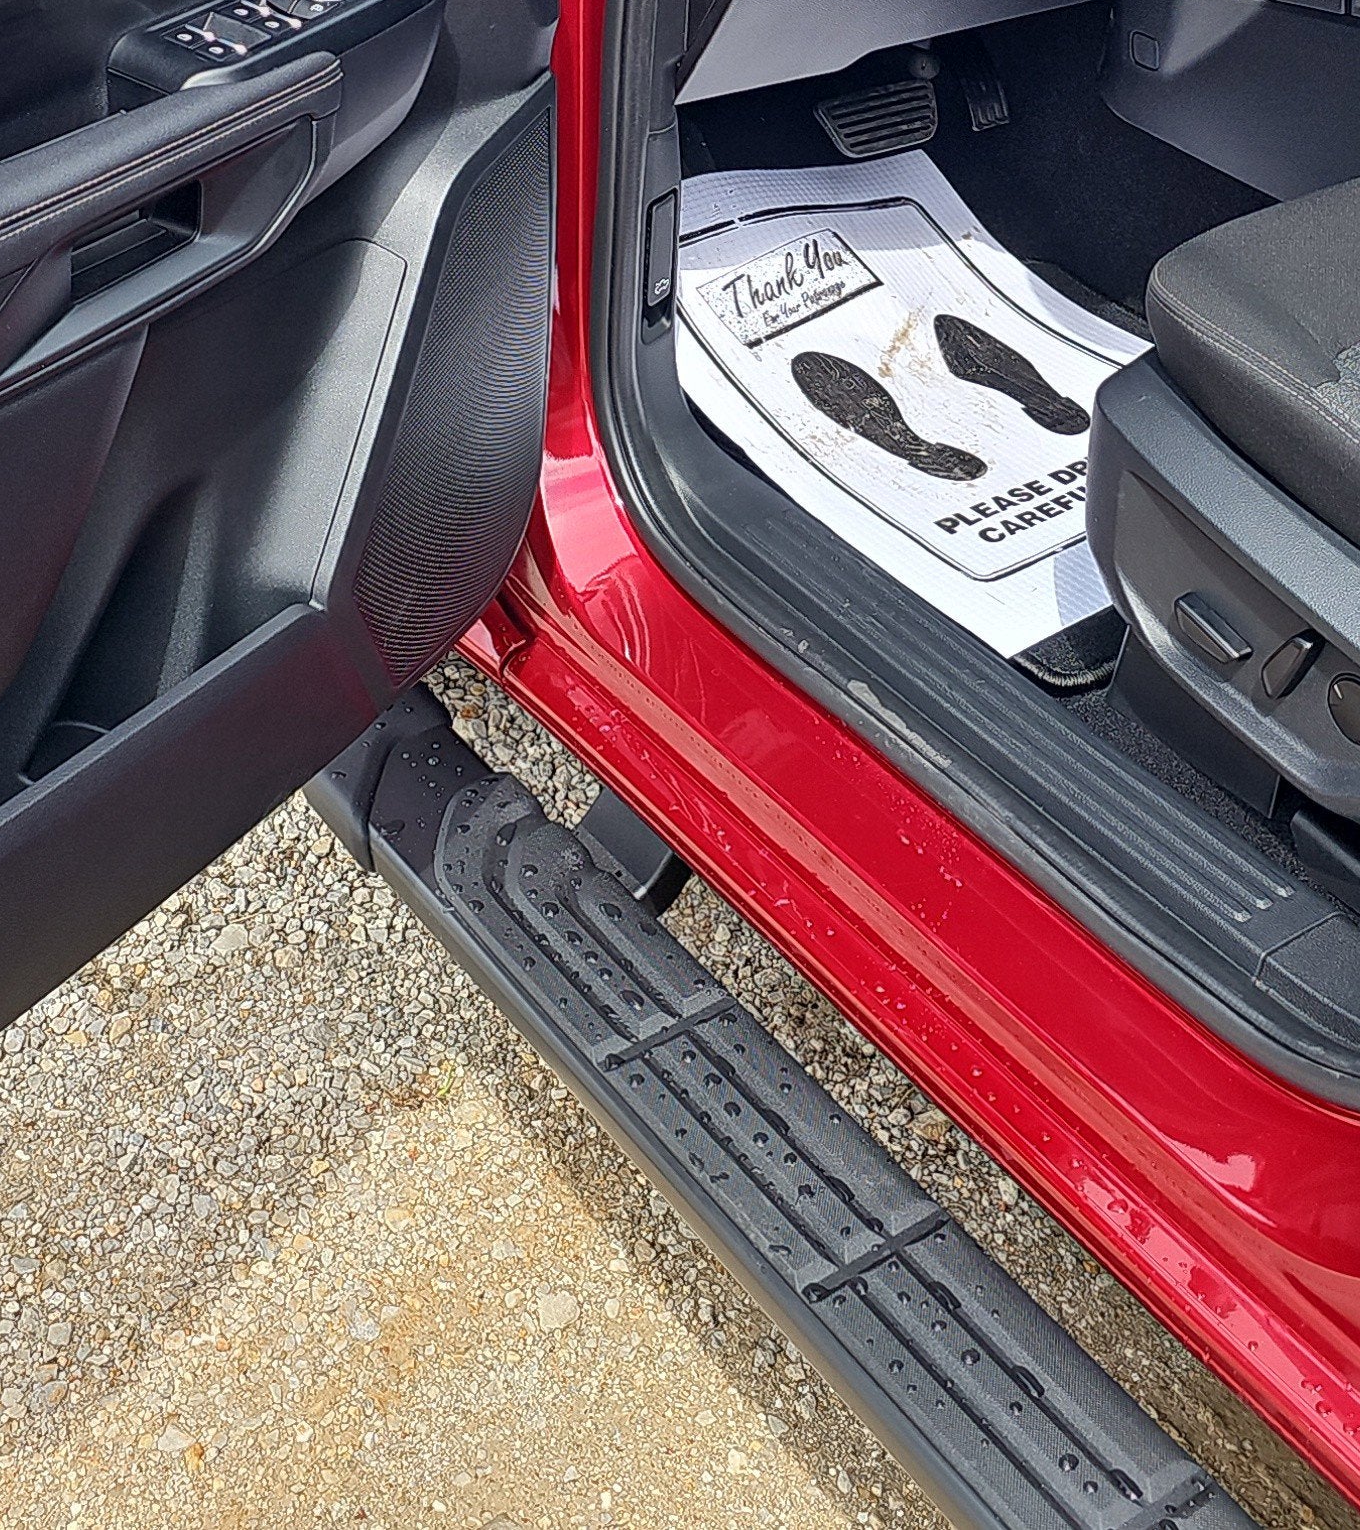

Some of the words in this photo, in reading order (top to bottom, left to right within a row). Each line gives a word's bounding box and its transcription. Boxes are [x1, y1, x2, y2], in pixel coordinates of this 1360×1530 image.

[721, 251, 805, 318] Thank
[803, 238, 850, 280] You
[779, 302, 801, 319] Your
[933, 479, 1054, 535] PLEASE
[1047, 456, 1089, 486] DR
[978, 485, 1087, 543] CAREFU
